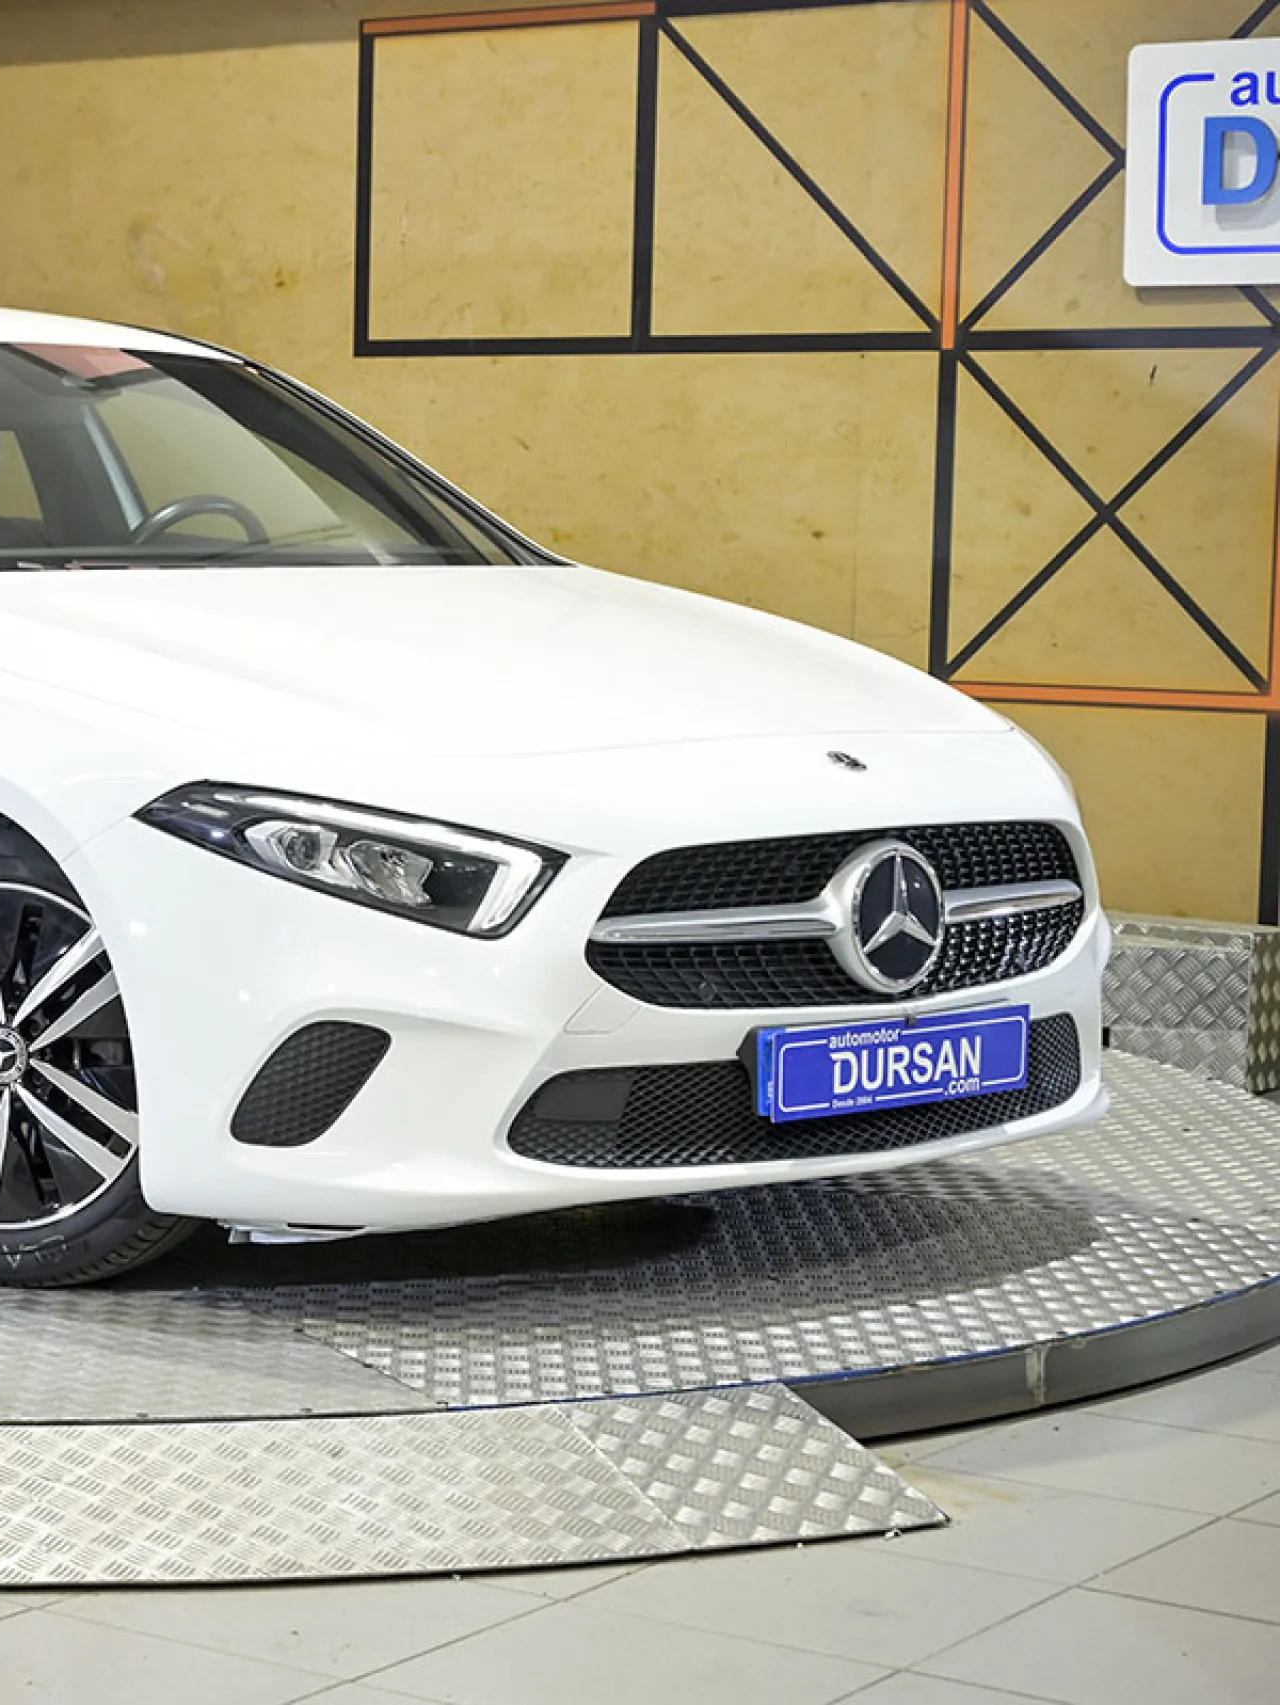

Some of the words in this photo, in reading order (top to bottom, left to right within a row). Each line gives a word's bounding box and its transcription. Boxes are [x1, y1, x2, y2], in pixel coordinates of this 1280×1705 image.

[829, 1028, 901, 1049] automotor
[830, 1034, 982, 1095] DURSAN
[944, 1077, 980, 1095] .com
